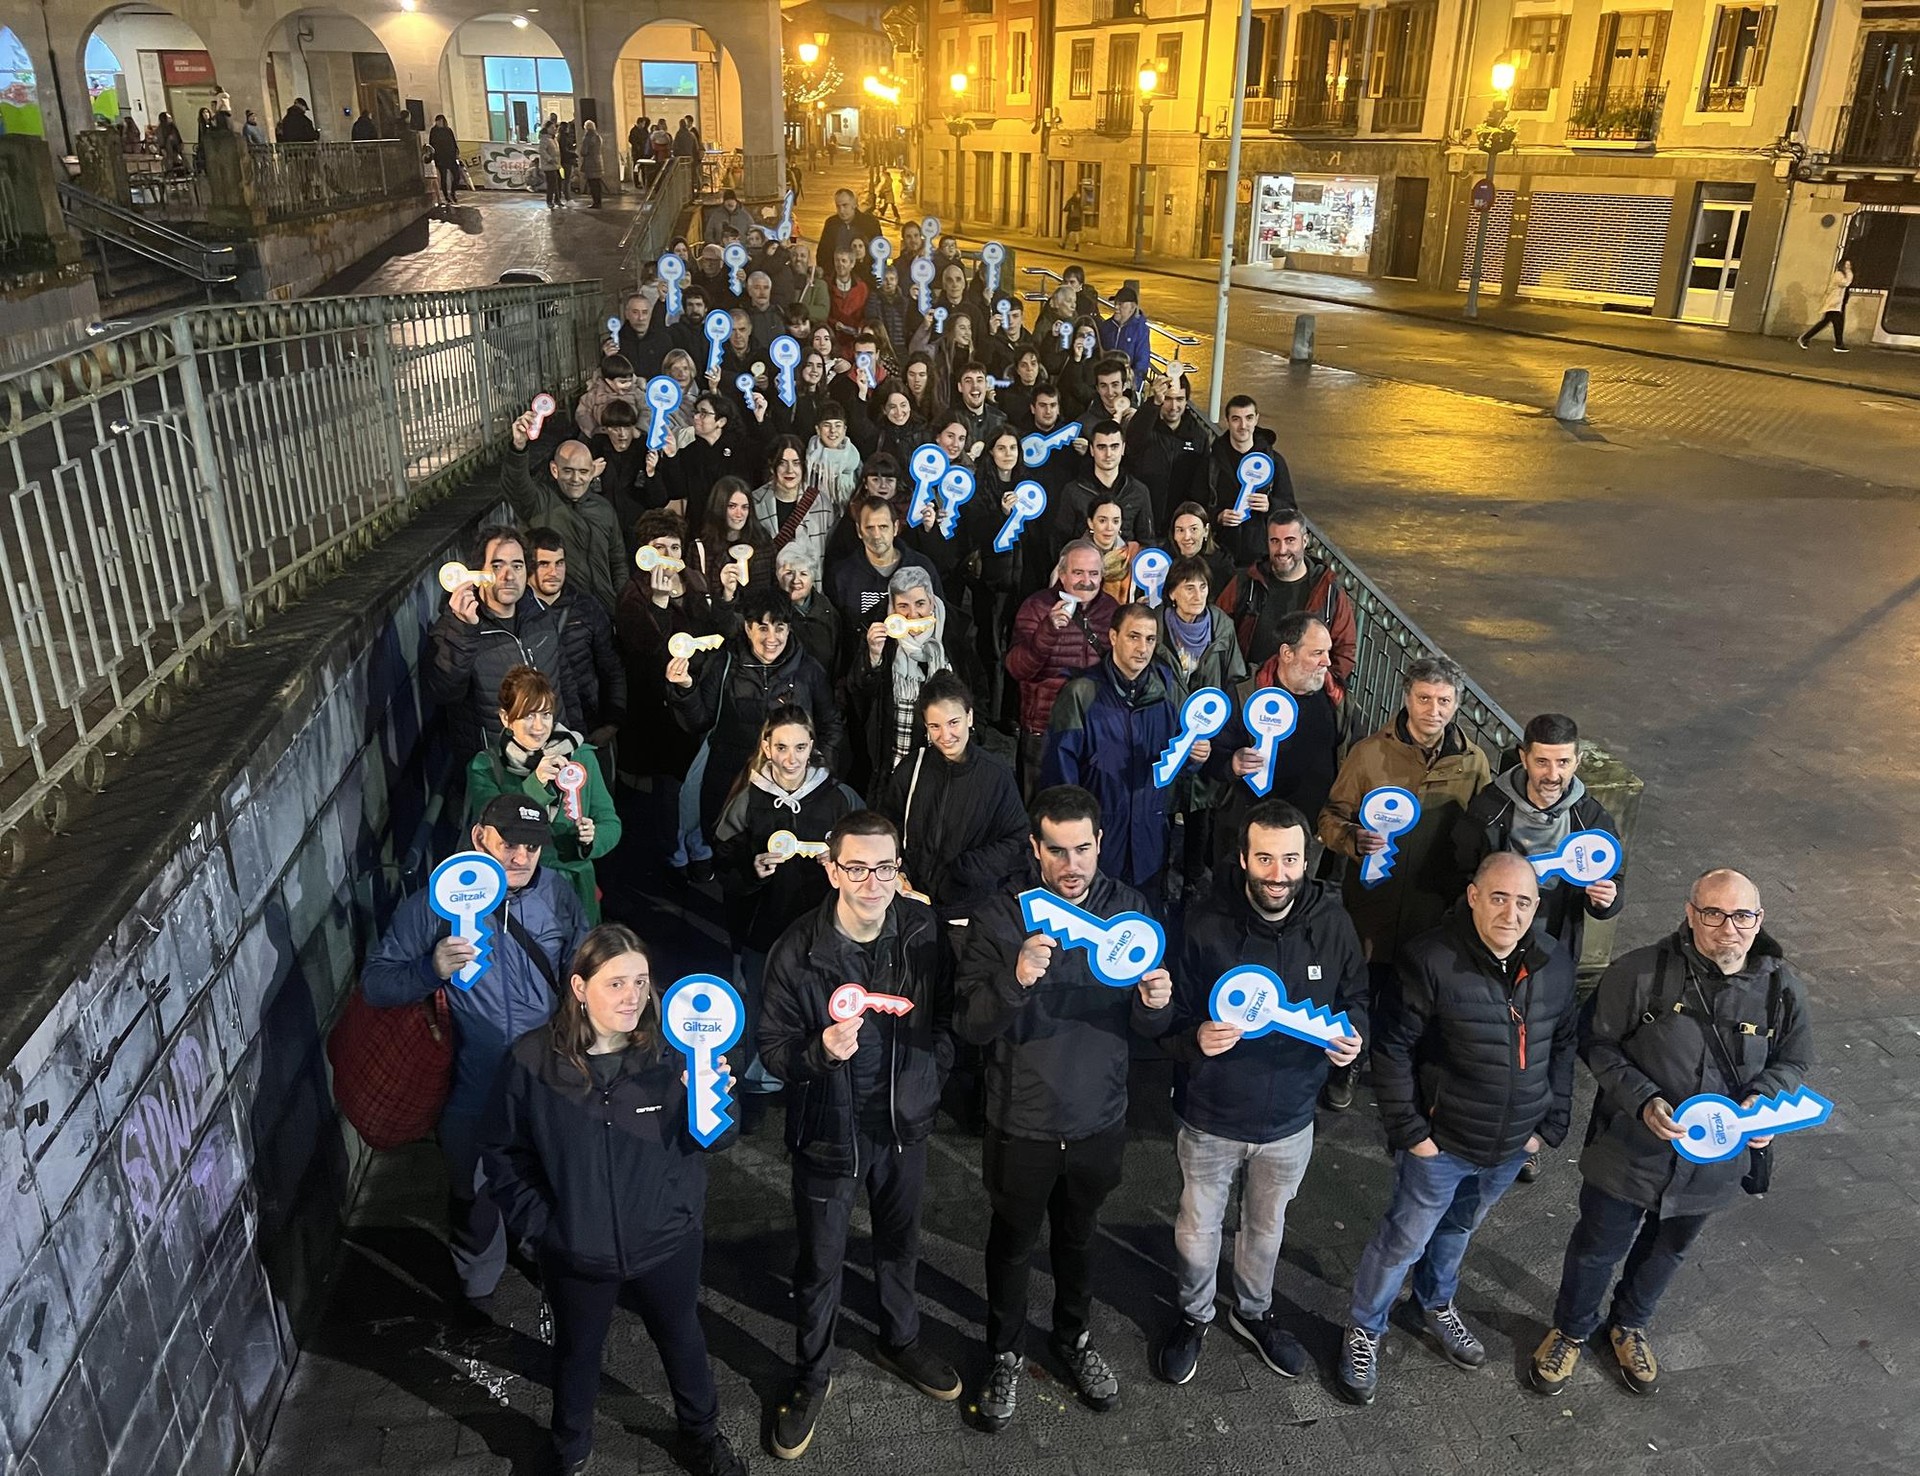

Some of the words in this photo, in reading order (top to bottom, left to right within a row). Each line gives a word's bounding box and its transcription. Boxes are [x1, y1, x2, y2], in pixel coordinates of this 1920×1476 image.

[1259, 714, 1282, 725] Llaves
[1373, 813, 1403, 824] Giltzak
[1575, 846, 1586, 873] Giltzak
[449, 891, 486, 903] Giltzak
[1107, 930, 1132, 963] Giltzak
[1246, 990, 1268, 1022] Giltzak
[682, 1021, 722, 1033] Giltzak
[1712, 1112, 1727, 1145] Giltzak
